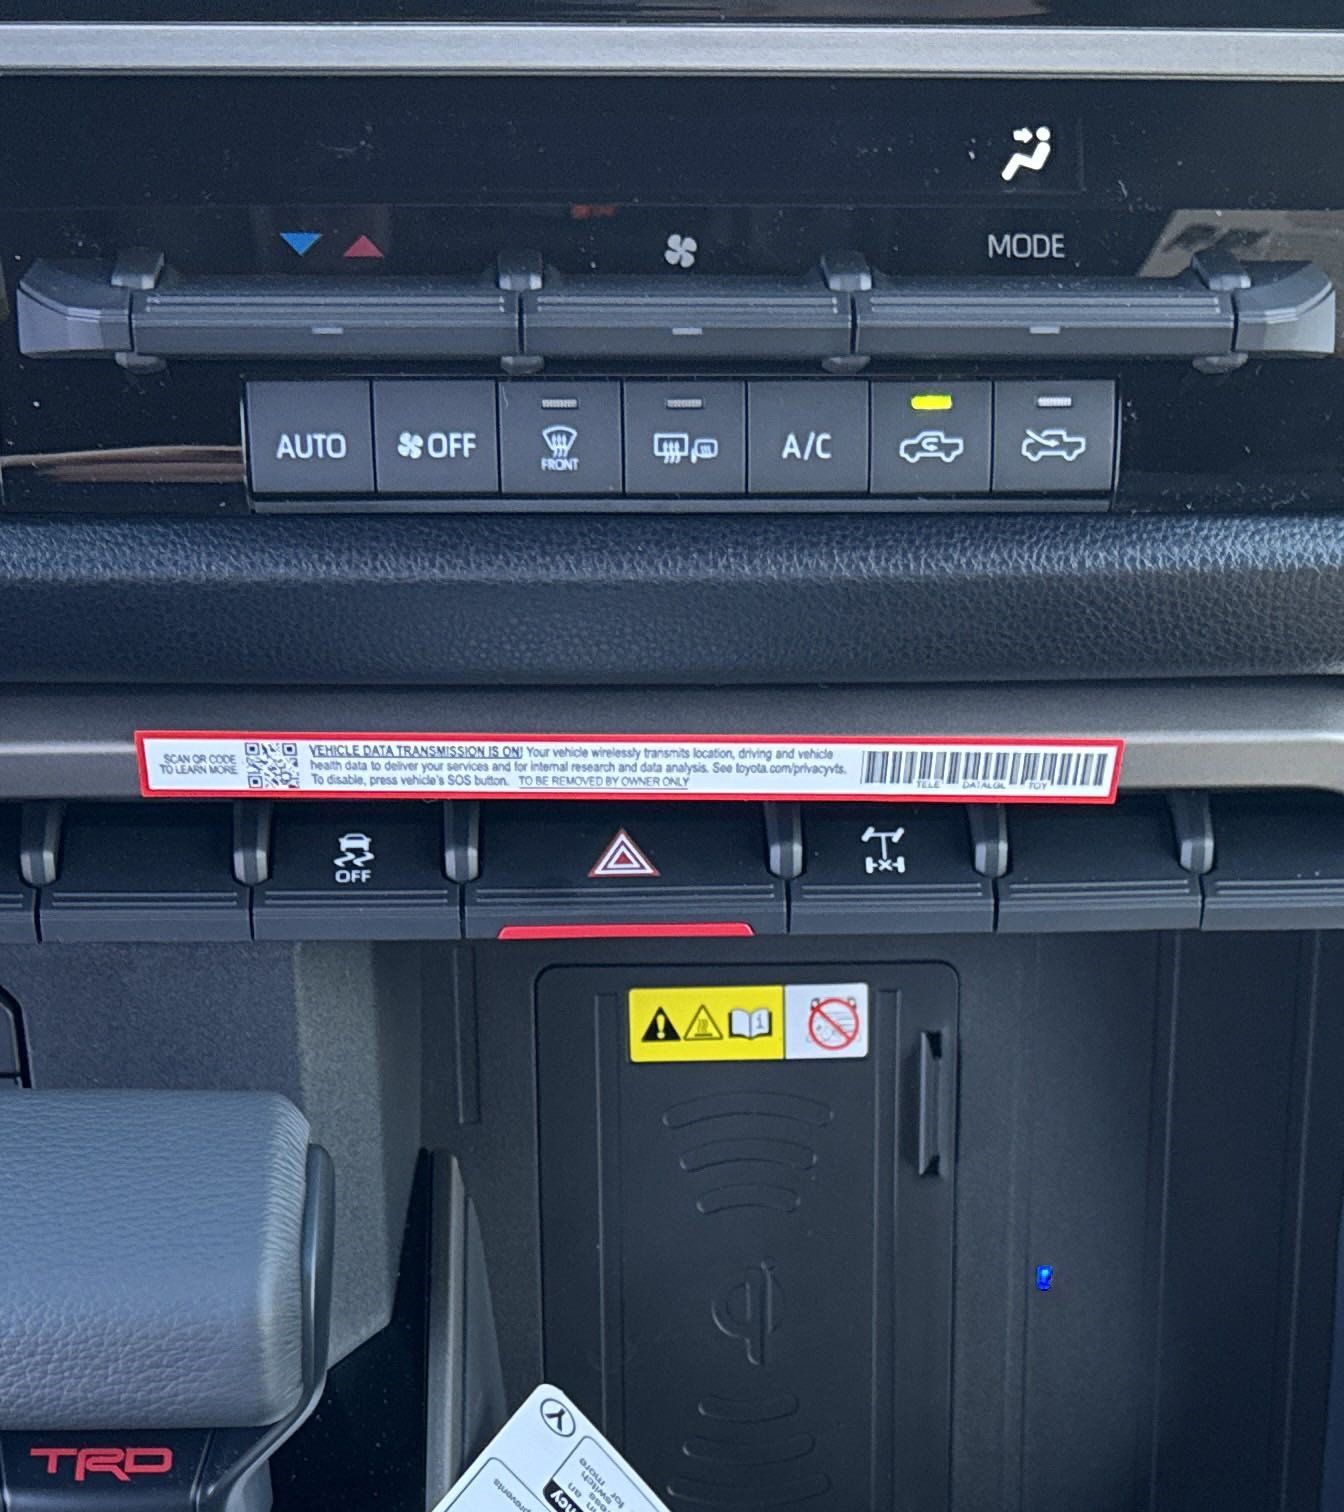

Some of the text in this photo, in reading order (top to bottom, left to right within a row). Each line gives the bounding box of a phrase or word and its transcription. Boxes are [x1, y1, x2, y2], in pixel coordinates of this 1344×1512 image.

[987, 232, 1066, 261] MODE
[275, 433, 347, 460] AUTO
[427, 433, 477, 460] OFF
[782, 433, 832, 460] A/C
[541, 457, 580, 472] FRONT
[309, 744, 834, 761] VEHICLE DATA TRANSMISSION IS ON! Your vehicle wirelessly transmits location, driving and vehicle
[160, 764, 237, 775] TO LEARN MORE
[310, 760, 847, 776] health data to deliver your services and for internal research and data analysis. See toyota.com/privacyvts.
[311, 773, 689, 788] To disable, press vehicle's SOS button. TO BE REMOVED BY OWNER ONLY
[334, 869, 372, 885] OFF
[30, 1447, 173, 1482] TRD
